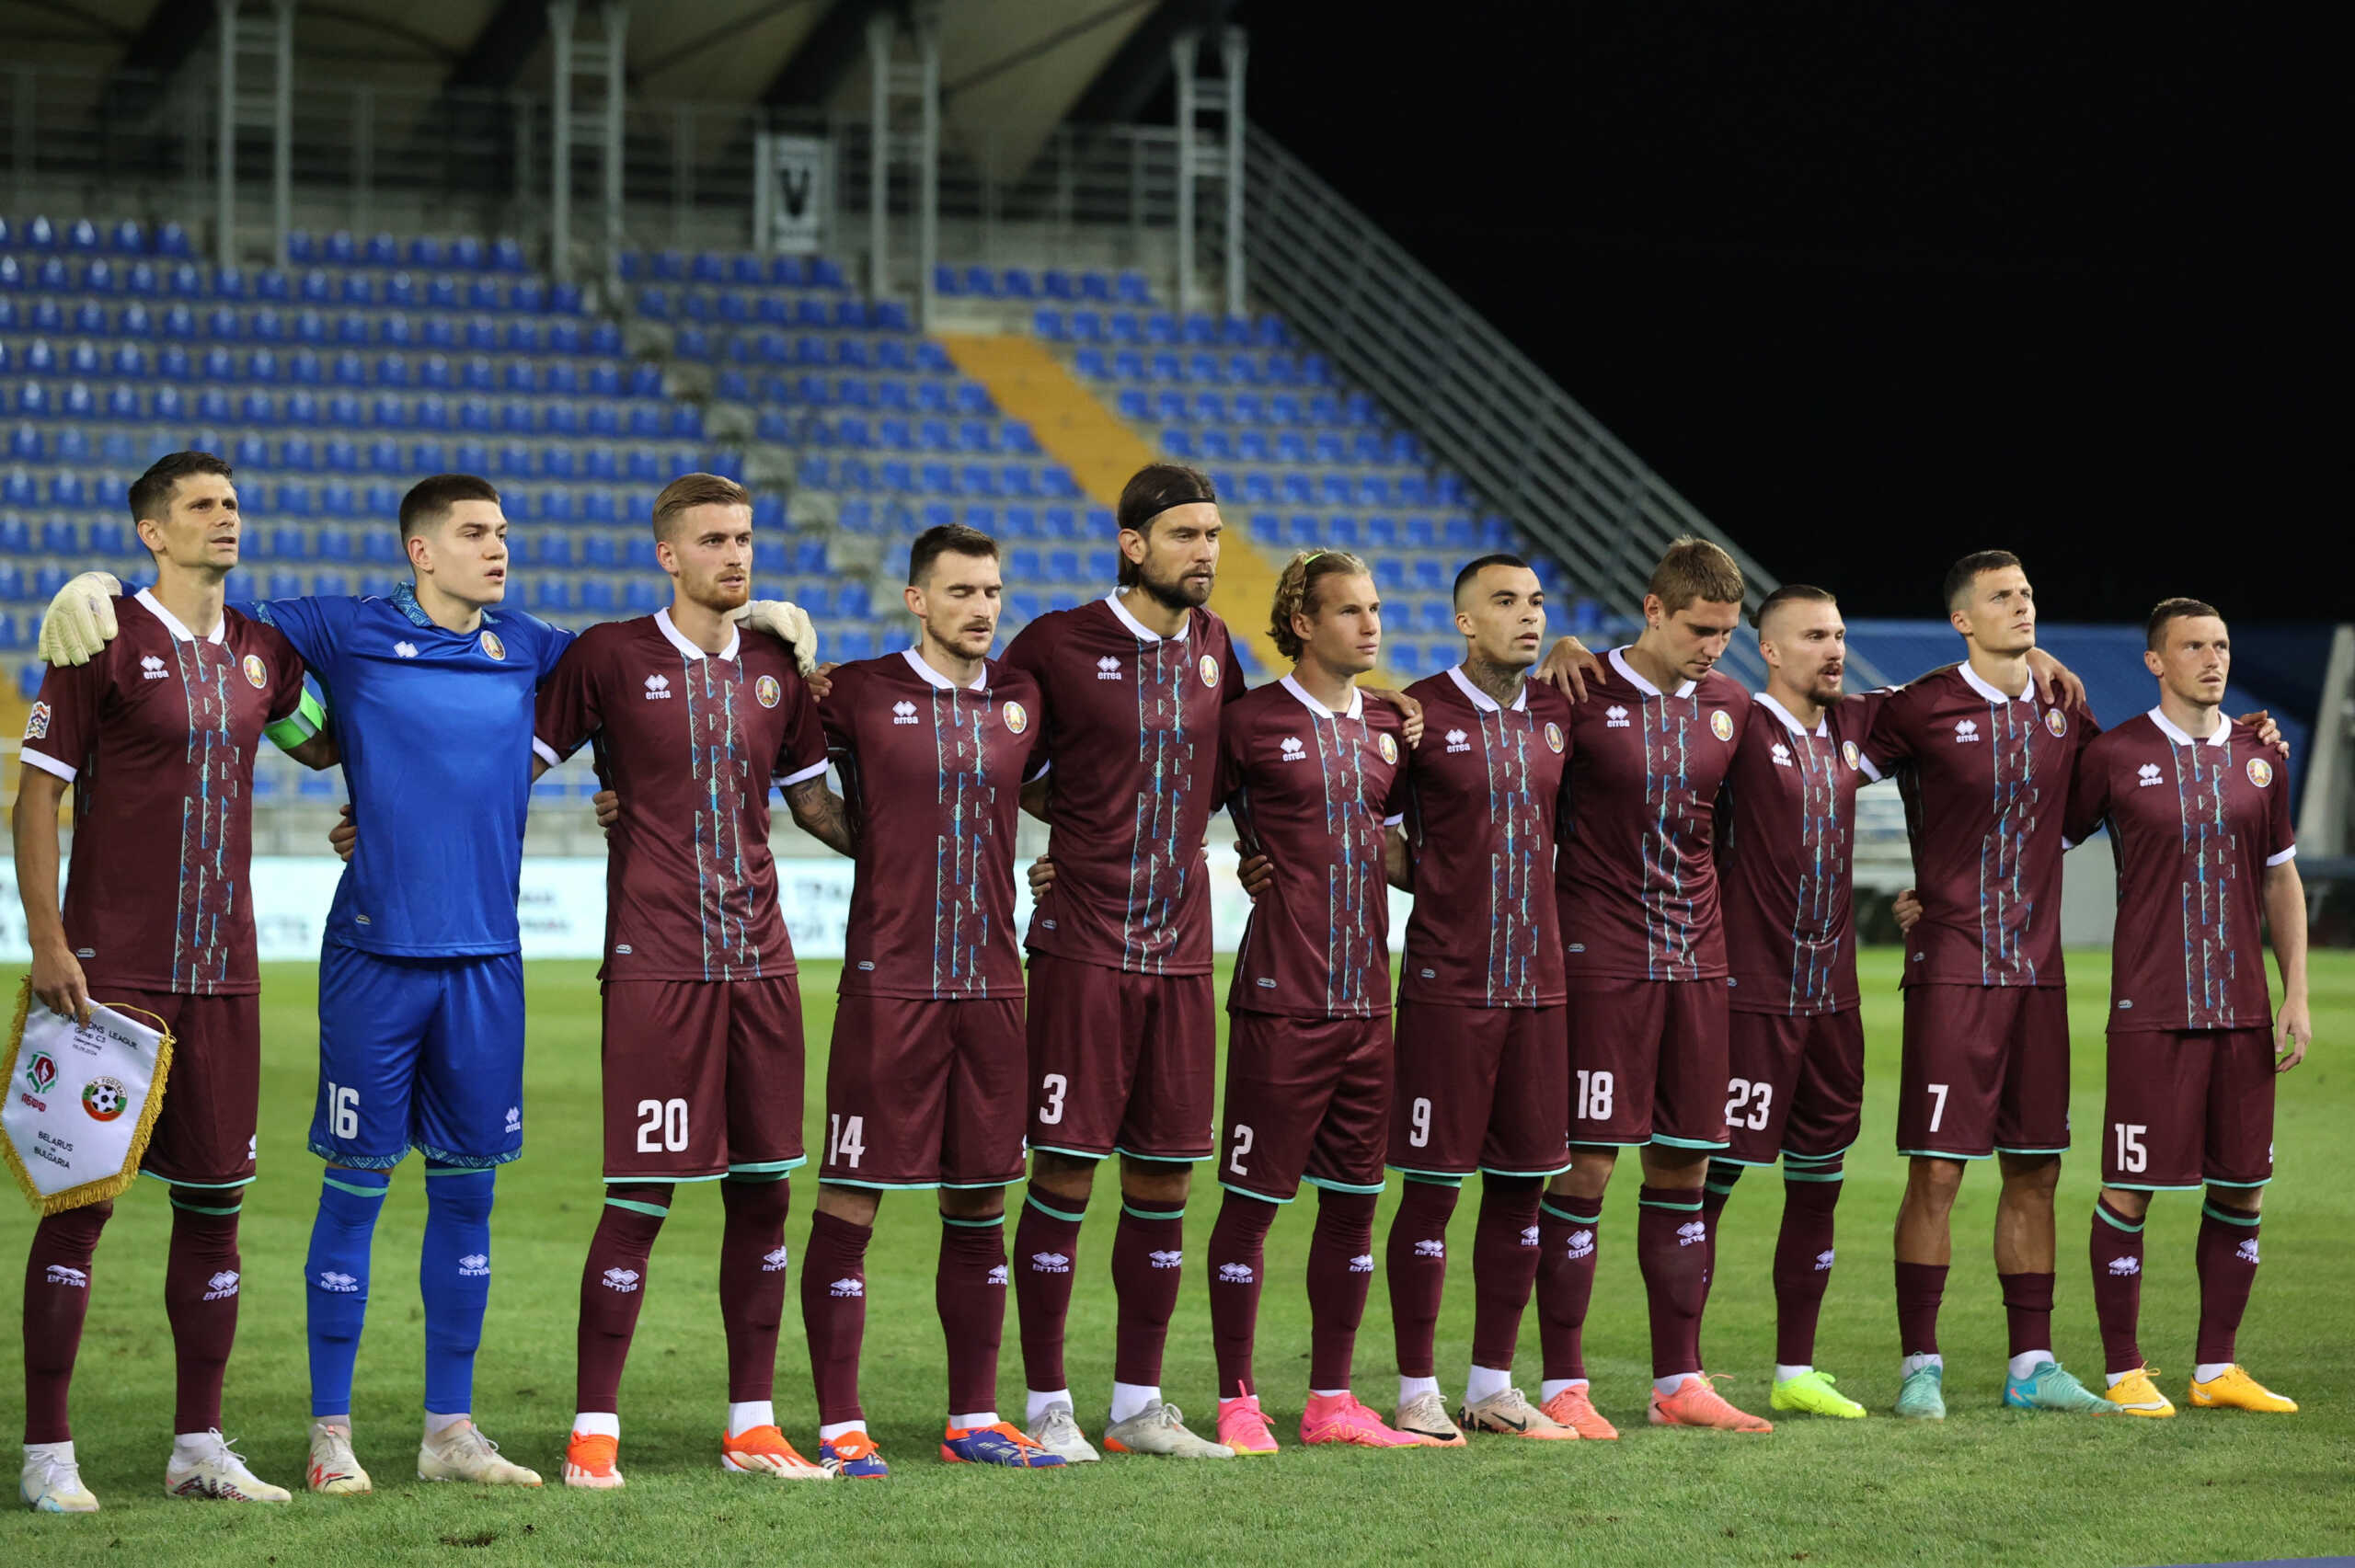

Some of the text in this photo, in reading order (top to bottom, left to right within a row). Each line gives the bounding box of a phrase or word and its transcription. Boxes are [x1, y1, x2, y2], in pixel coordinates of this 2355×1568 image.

[328, 1082, 360, 1139] 16
[1039, 1073, 1067, 1125] 3
[1577, 1070, 1614, 1120] 18
[1726, 1078, 1773, 1131] 23
[1927, 1083, 1949, 1133] 7
[39, 1131, 74, 1152] BELARUS
[638, 1098, 689, 1153] 20
[829, 1114, 866, 1168] 14
[1409, 1097, 1431, 1148] 9
[2115, 1123, 2148, 1173] 15
[34, 1146, 71, 1169] BULGARIA
[1229, 1124, 1254, 1176] 2
